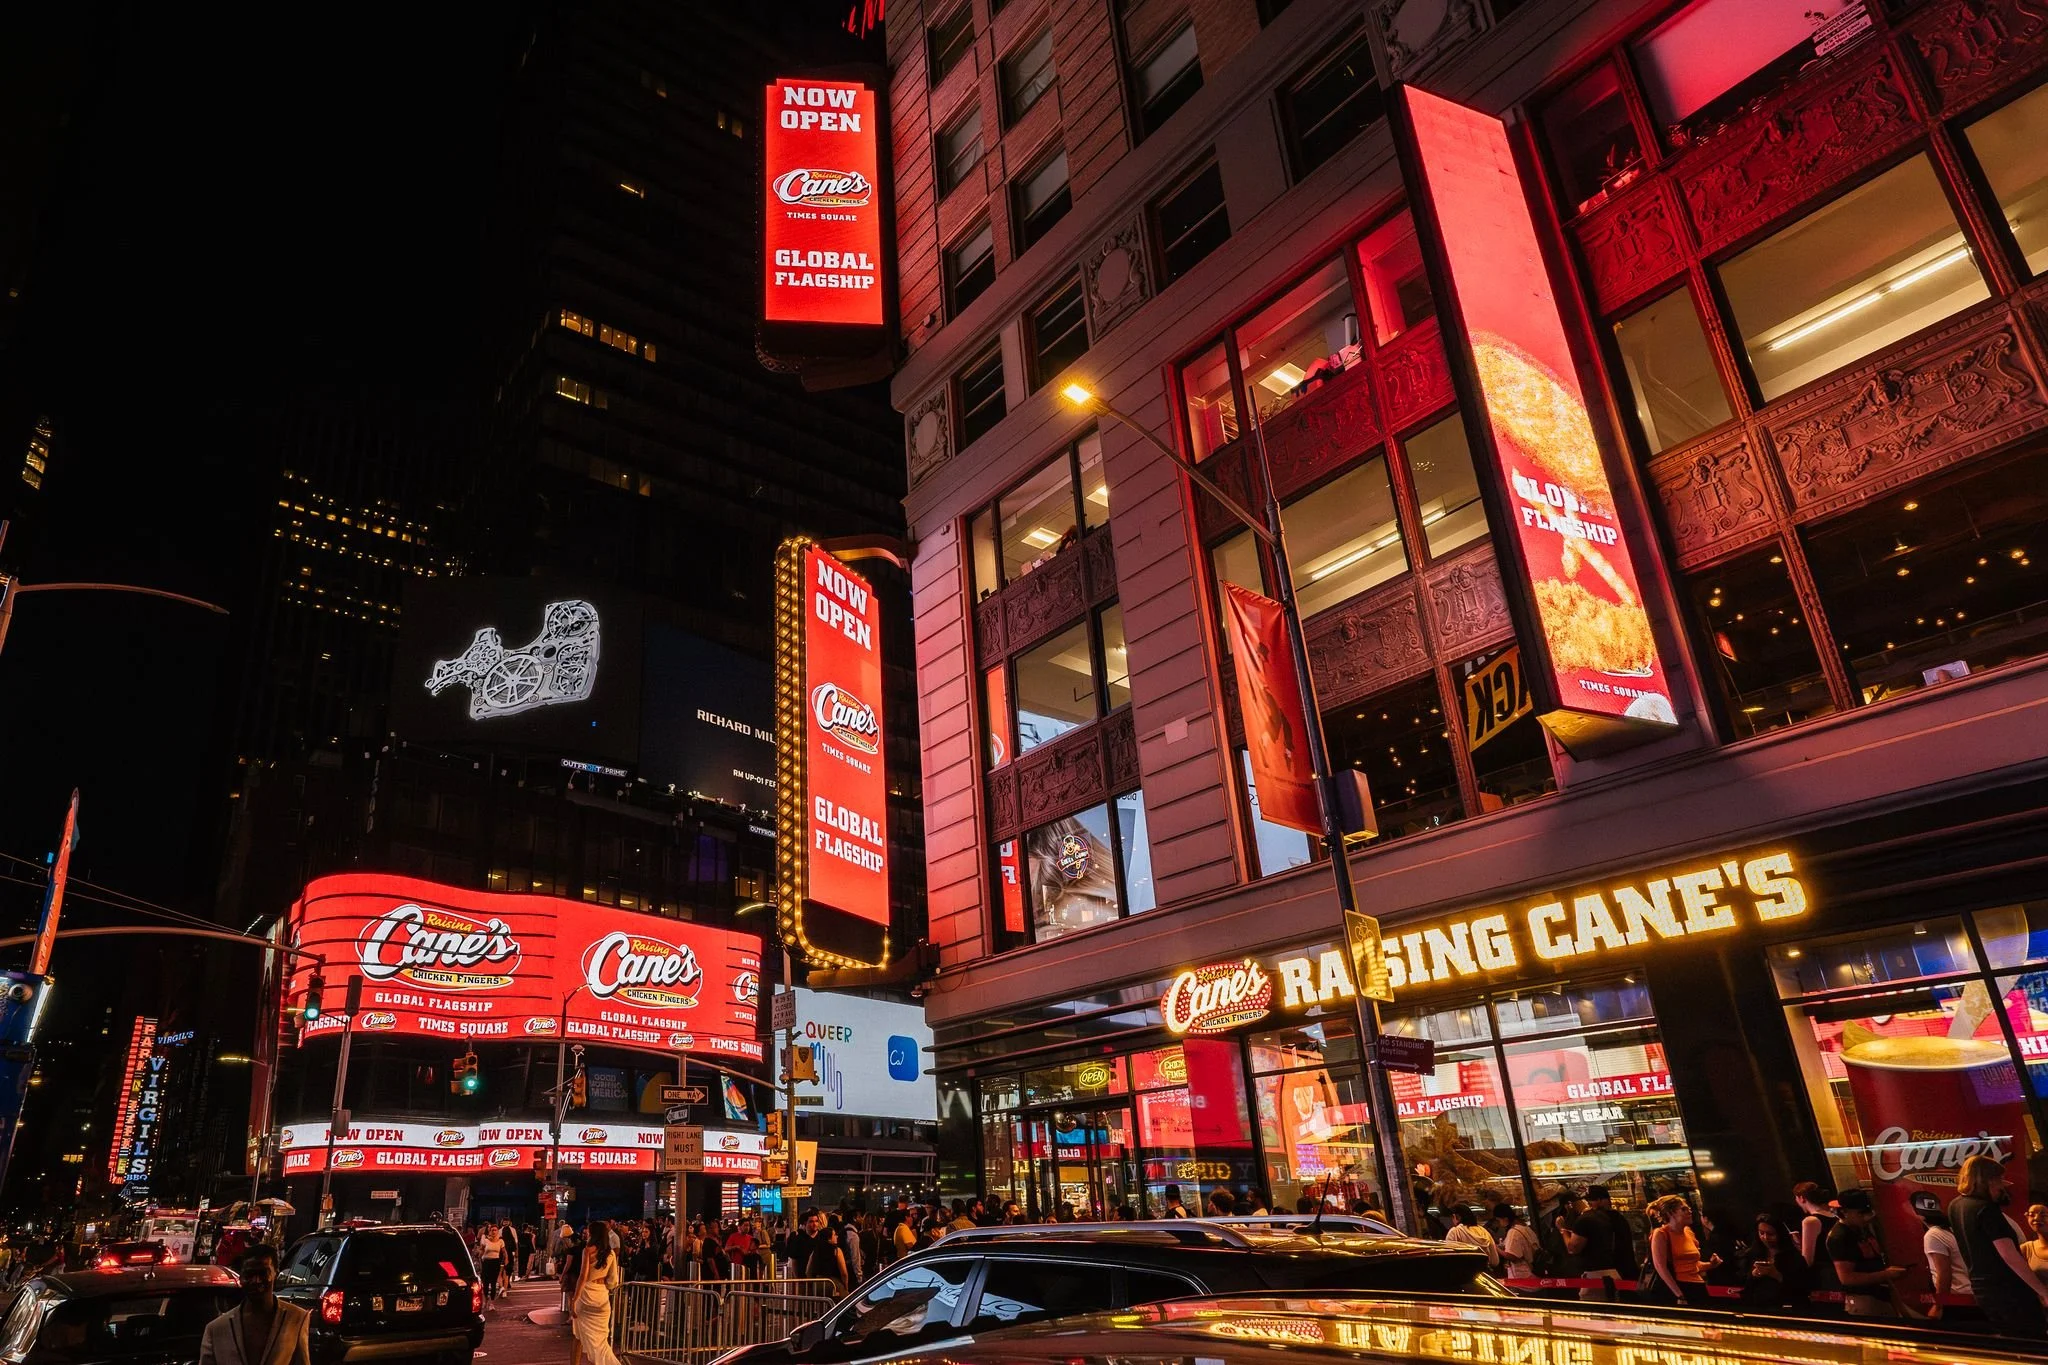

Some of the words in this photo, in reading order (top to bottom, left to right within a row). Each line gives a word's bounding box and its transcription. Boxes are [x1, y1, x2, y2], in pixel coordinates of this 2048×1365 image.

[784, 86, 856, 108] NOW
[780, 110, 861, 132] OPEN
[811, 171, 842, 180] Raising
[779, 169, 870, 203] Cane's
[787, 212, 817, 220] TIMES
[821, 213, 857, 221] SQUARE
[775, 249, 874, 270] GLOBAL
[775, 271, 874, 289] FLAGSHIP
[1521, 507, 1617, 545] FLAGSHIP
[817, 559, 868, 616] NOW
[815, 596, 872, 651] OPEN
[1579, 680, 1610, 693] TIMES
[815, 683, 878, 735] Cane's
[697, 709, 751, 736] RICHARD
[822, 743, 844, 762] TIMES
[845, 753, 872, 774] SQUARE
[733, 769, 744, 780] RM
[745, 772, 763, 785] UP-01
[815, 796, 883, 847] GLOBAL
[815, 829, 884, 873] FLAGSHIP
[426, 914, 474, 932] Raising
[1278, 916, 1518, 1008] RASING
[1526, 852, 1807, 960] CANE'S
[363, 905, 519, 979] Cane's
[632, 939, 670, 957] Raising
[588, 932, 701, 996] Cane's
[412, 970, 455, 983] CHICKEN
[457, 975, 500, 985] FINGERS
[1199, 968, 1235, 982] Raising
[375, 992, 424, 1007] GLOBAL
[428, 997, 493, 1012] FLAGSHIP
[627, 989, 658, 1001] CHICKEN
[659, 993, 689, 1006] FINGERS
[1166, 959, 1268, 1033] Cane's
[775, 1002, 792, 1012] CLOSED
[600, 1011, 638, 1025] GLOBAL
[641, 1015, 687, 1030] FLAGSHIP
[1201, 1015, 1230, 1028] CHICKEN
[1232, 1011, 1262, 1023] FINGERS
[158, 1030, 194, 1044] VIRGIL'S
[361, 1013, 396, 1028] Cane's
[418, 1017, 455, 1033] TIMES
[459, 1022, 508, 1035] SQUARE
[524, 1018, 557, 1034] Cane's
[567, 1021, 610, 1037] GLOBAL
[612, 1028, 661, 1043] FLAGSHIP
[668, 1033, 695, 1048] Cane's
[710, 1038, 739, 1052] TIMES
[805, 1021, 852, 1043] QUEER
[1381, 1047, 1409, 1055] Anytime
[1391, 1040, 1424, 1049] STANDING
[1082, 1072, 1105, 1082] OPEN
[591, 1088, 627, 1098] MERICA
[687, 1091, 700, 1099] WAY
[1567, 1078, 1637, 1099] GLOBAL
[1417, 1094, 1484, 1114] FLAGSHIP
[1583, 1107, 1625, 1122] GEAR
[325, 1129, 361, 1141] NW
[366, 1128, 403, 1141] OPEN
[434, 1130, 465, 1146] Cane's
[506, 1127, 543, 1142] OPEN
[579, 1128, 608, 1143] Cane's
[637, 1133, 664, 1145] NOW
[667, 1131, 684, 1139] RIGHT
[686, 1131, 701, 1139] LANE
[674, 1144, 694, 1152] MUST
[1872, 1127, 2011, 1181] Cane's
[331, 1150, 364, 1167] Cane's
[376, 1153, 427, 1166] GLOBAL
[488, 1149, 520, 1167] Cane's
[546, 1151, 586, 1165] TMES
[597, 1152, 637, 1165] SQUARE
[726, 1157, 759, 1170] FLAGSHIP
[667, 1158, 682, 1166] TURN
[684, 1158, 701, 1166] RIGHT
